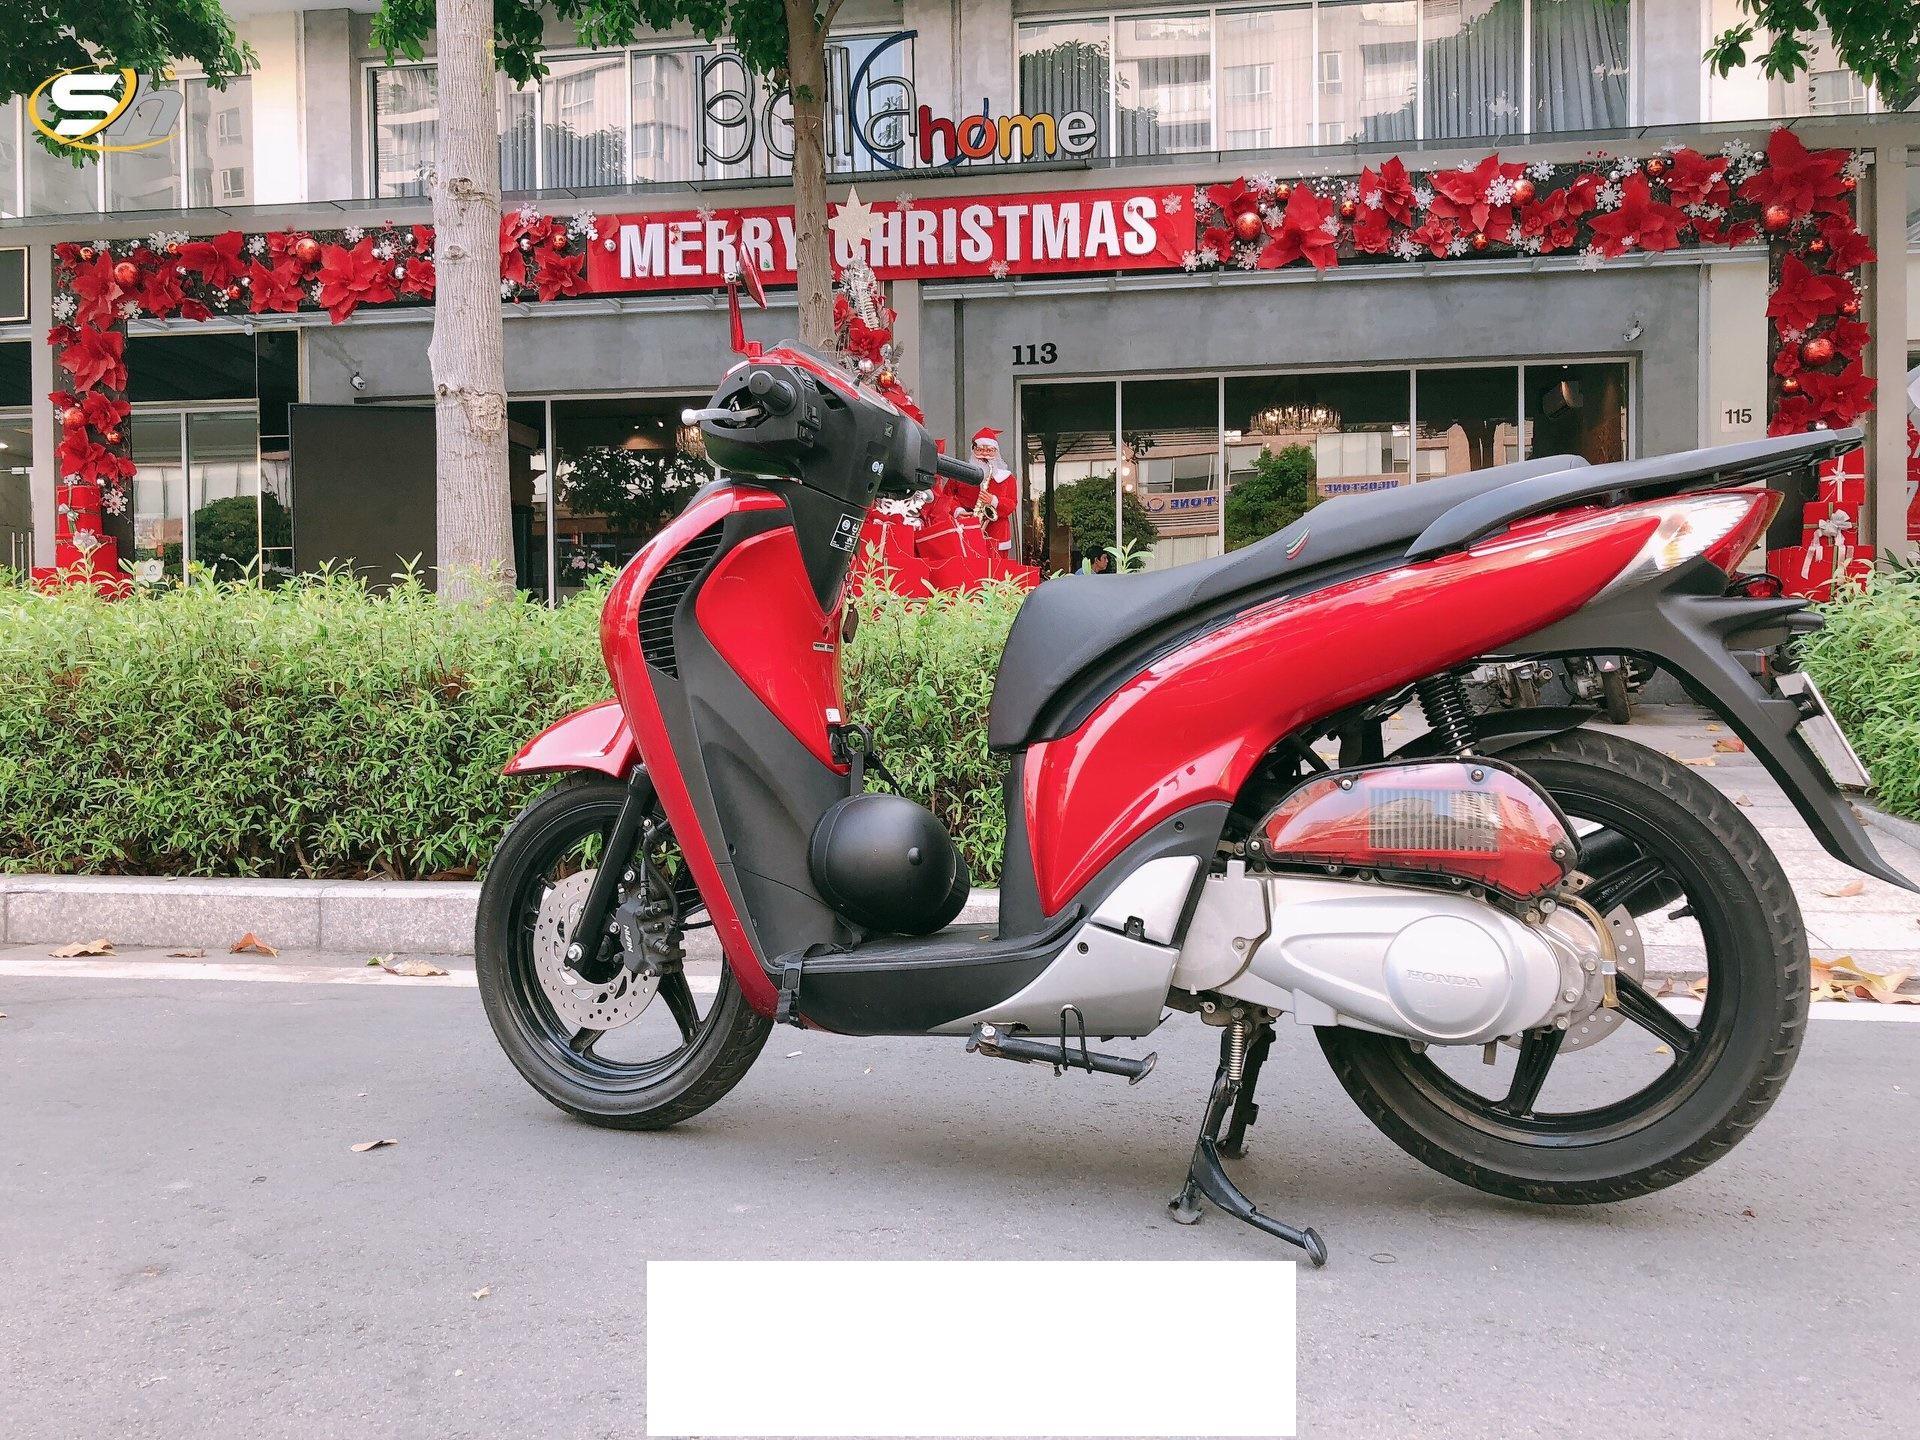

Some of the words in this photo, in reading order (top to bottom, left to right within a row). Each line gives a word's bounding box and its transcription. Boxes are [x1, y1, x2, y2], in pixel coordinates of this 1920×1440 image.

[918, 104, 1098, 165] home
[619, 216, 797, 279] MERRY
[1012, 342, 1058, 366] 113
[1724, 409, 1752, 424] 115
[1406, 969, 1484, 989] HONDA
